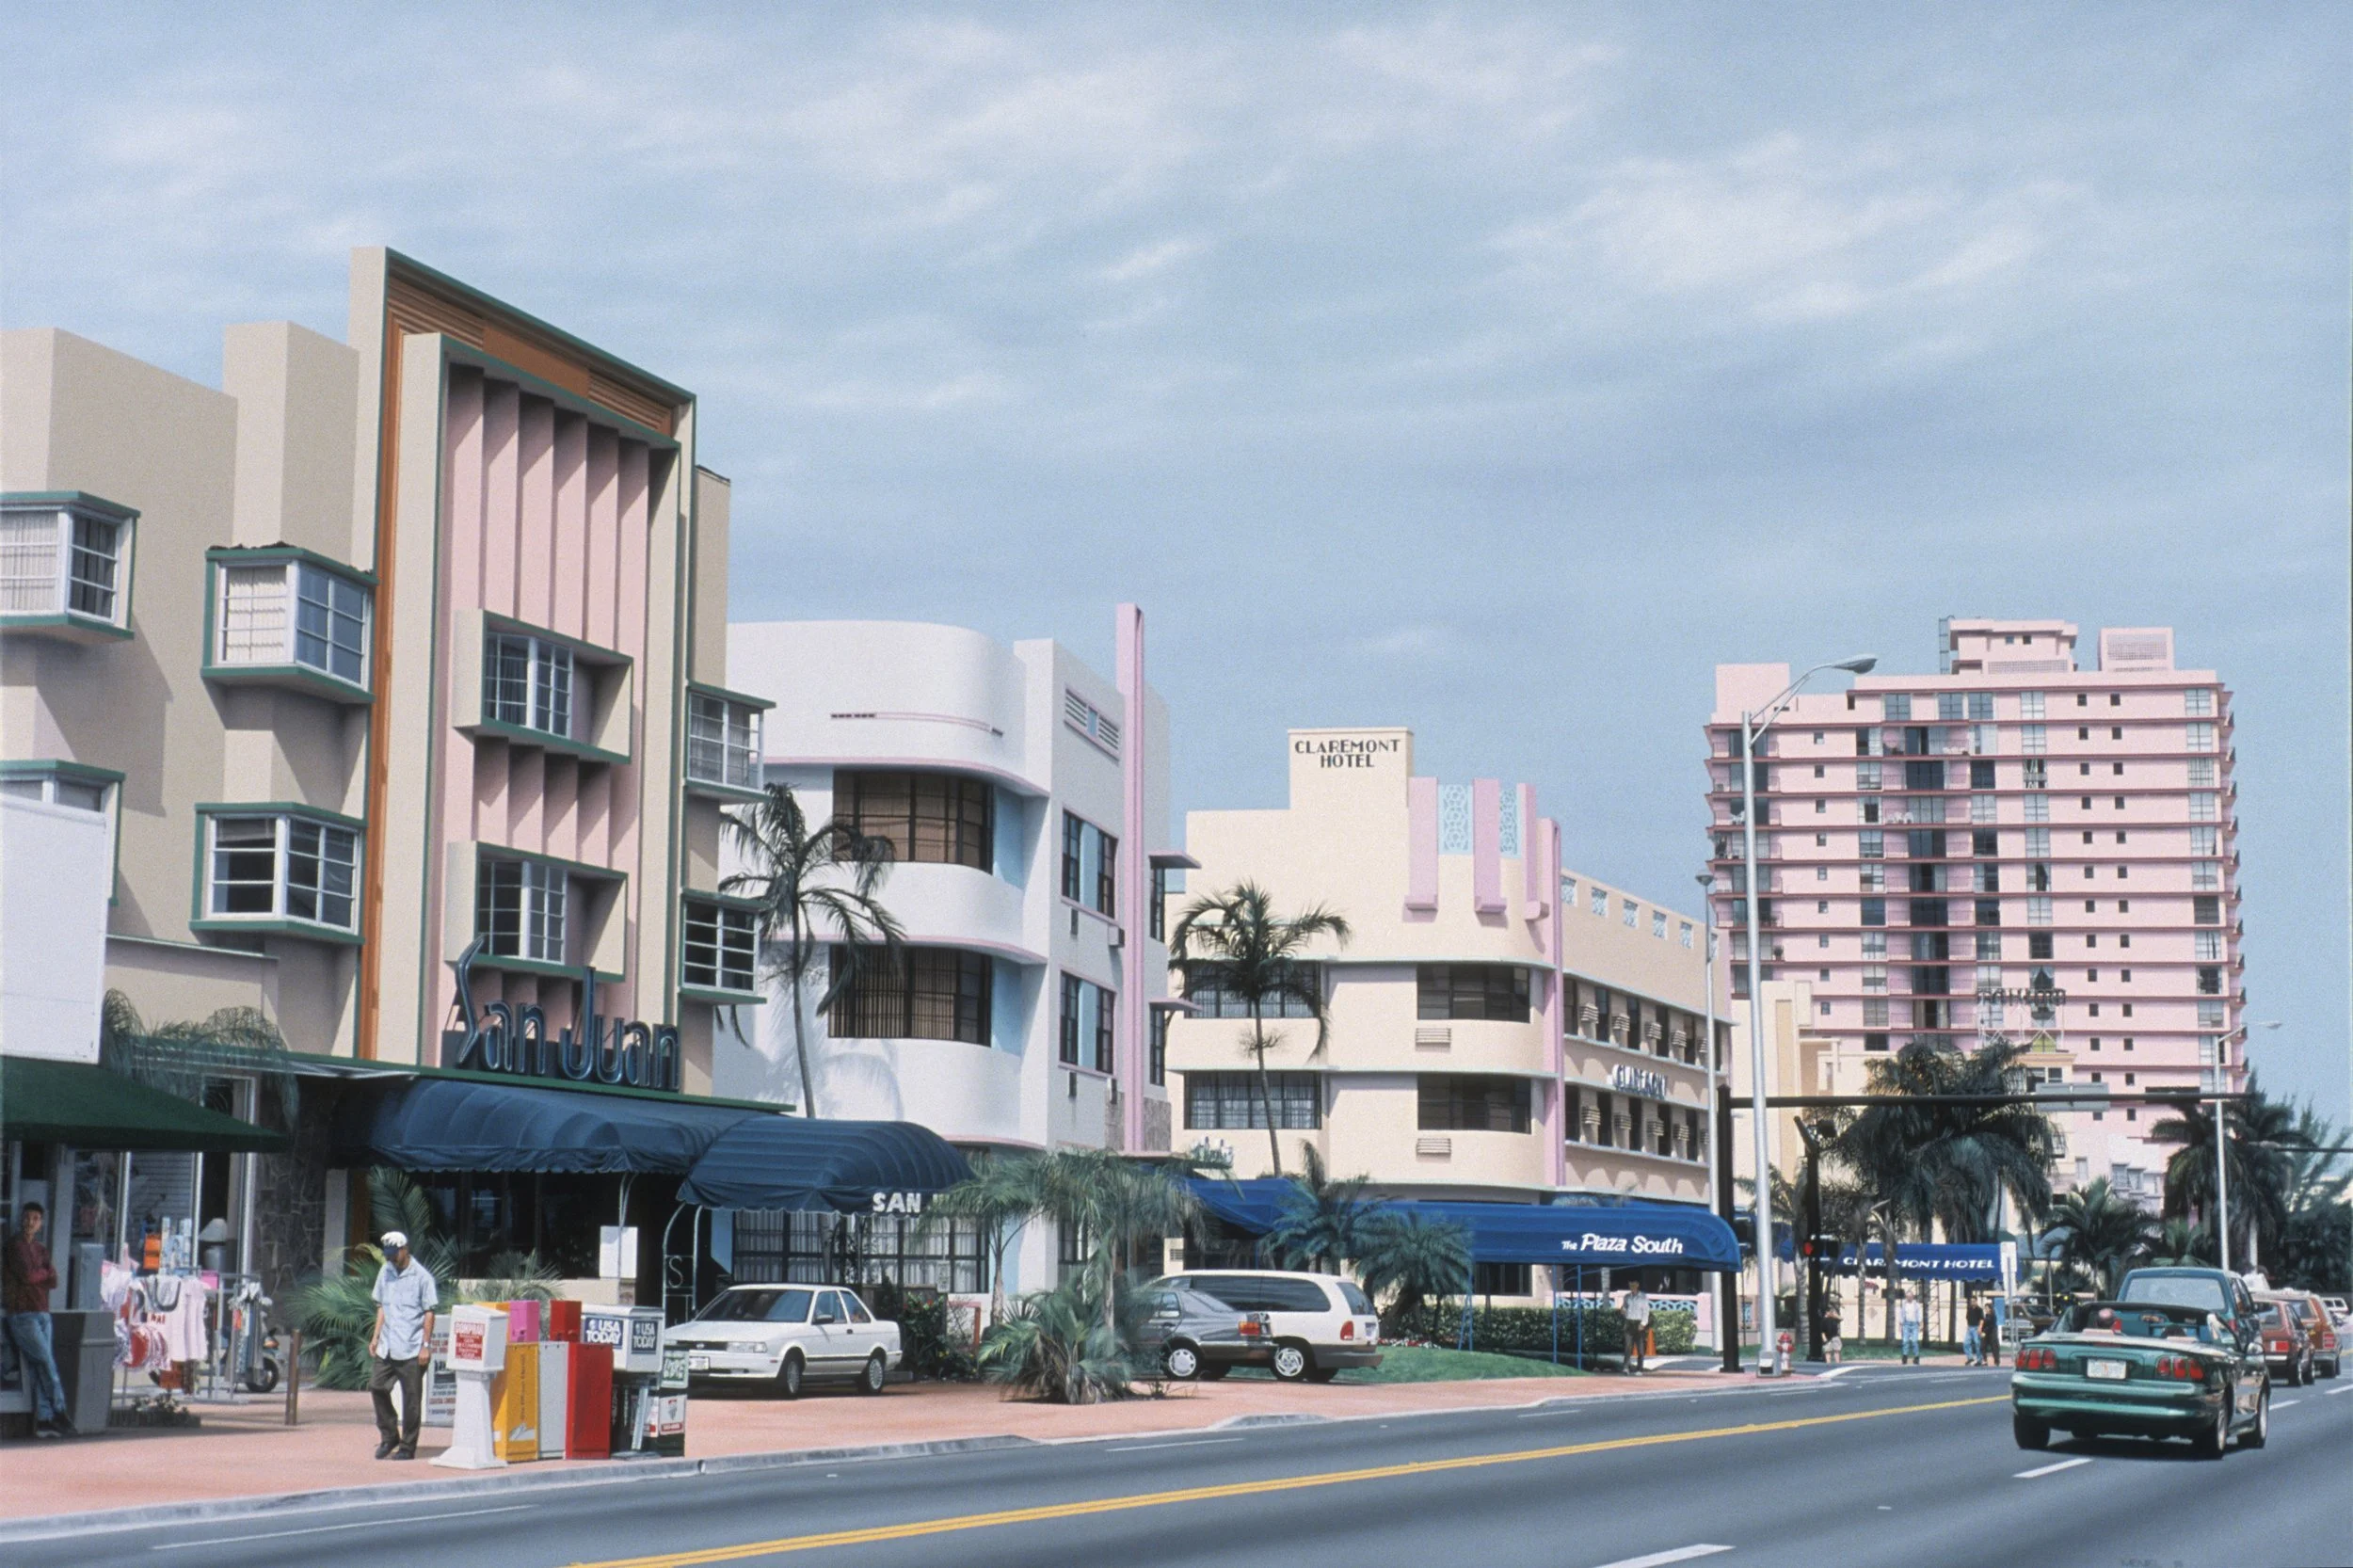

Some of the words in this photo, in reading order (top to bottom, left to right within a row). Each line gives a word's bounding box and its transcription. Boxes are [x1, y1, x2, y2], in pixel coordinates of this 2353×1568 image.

[1294, 739, 1400, 753] CLAREMONT
[1321, 754, 1374, 768] HOTEL
[455, 933, 546, 1075] San
[559, 966, 680, 1090] Juan
[872, 1192, 921, 1213] SAN
[1580, 1233, 1627, 1252] Plaza
[1631, 1235, 1683, 1255] South
[1943, 1259, 1994, 1269] HOTEL
[599, 1320, 620, 1333] USA
[641, 1322, 655, 1336] USA
[585, 1330, 621, 1344] TODAY
[633, 1336, 656, 1349] TODAY
